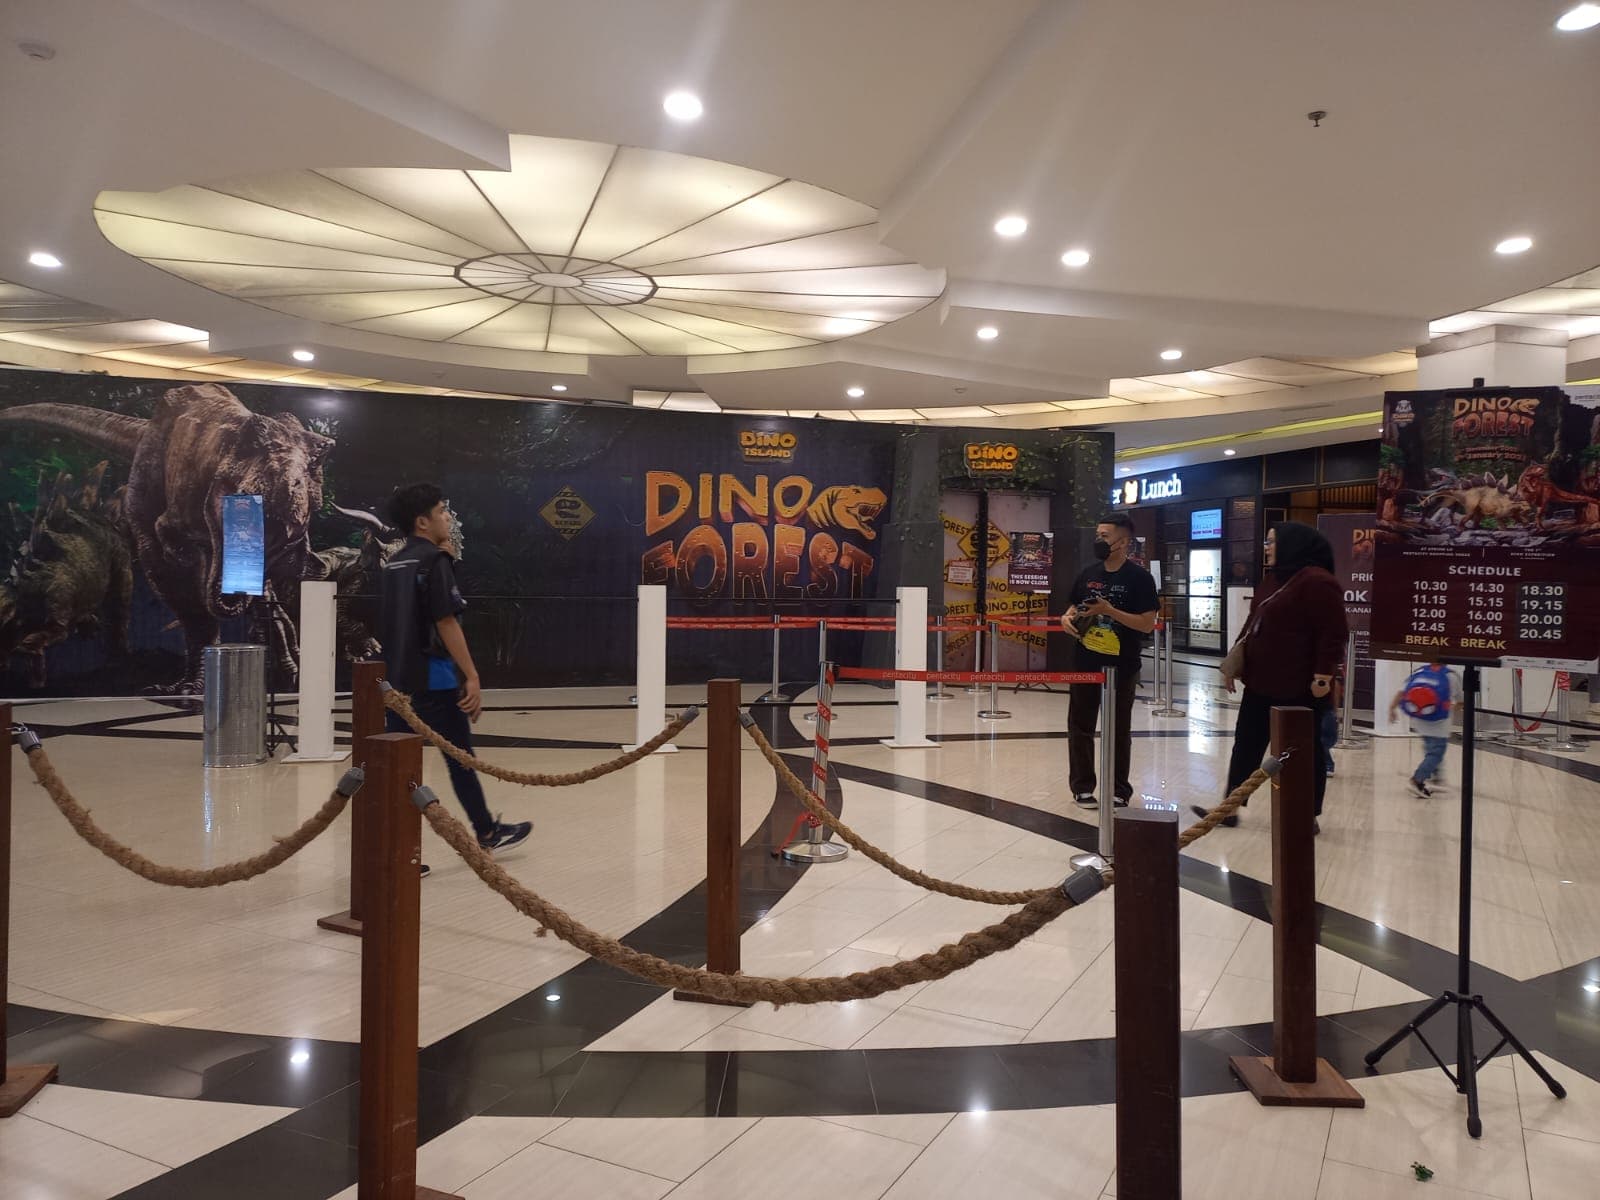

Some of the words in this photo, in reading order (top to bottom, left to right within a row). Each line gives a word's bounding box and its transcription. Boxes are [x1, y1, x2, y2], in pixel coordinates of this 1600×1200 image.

[1453, 397, 1512, 417] DINO
[1453, 412, 1534, 437] FOREST
[1141, 472, 1182, 500] Lunch
[645, 470, 814, 537] DINO
[641, 522, 875, 606] FOREST
[1448, 565, 1521, 577] SCHEDULE
[1413, 581, 1448, 591] 10.30
[1469, 583, 1504, 593] 14.30
[1522, 585, 1563, 596] 18.30
[1012, 599, 1048, 610] FOREST
[1413, 594, 1447, 604] 11.15
[1468, 597, 1504, 607] 15.15
[1521, 600, 1562, 610] 19.15
[1412, 608, 1446, 618] 12.00
[1467, 611, 1503, 621] 16.00
[1520, 614, 1562, 625] 20.00
[1411, 622, 1446, 632] 12.45
[1466, 625, 1502, 635] 16.45
[1519, 629, 1562, 639] 20.45
[1405, 635, 1449, 646] BREAK
[1461, 638, 1507, 649] BREAK
[882, 671, 917, 680] pentacity
[926, 672, 960, 681] pentacity
[970, 672, 1005, 682] pentacity
[1015, 673, 1050, 682] pentacity
[1060, 673, 1097, 682] pentacity
